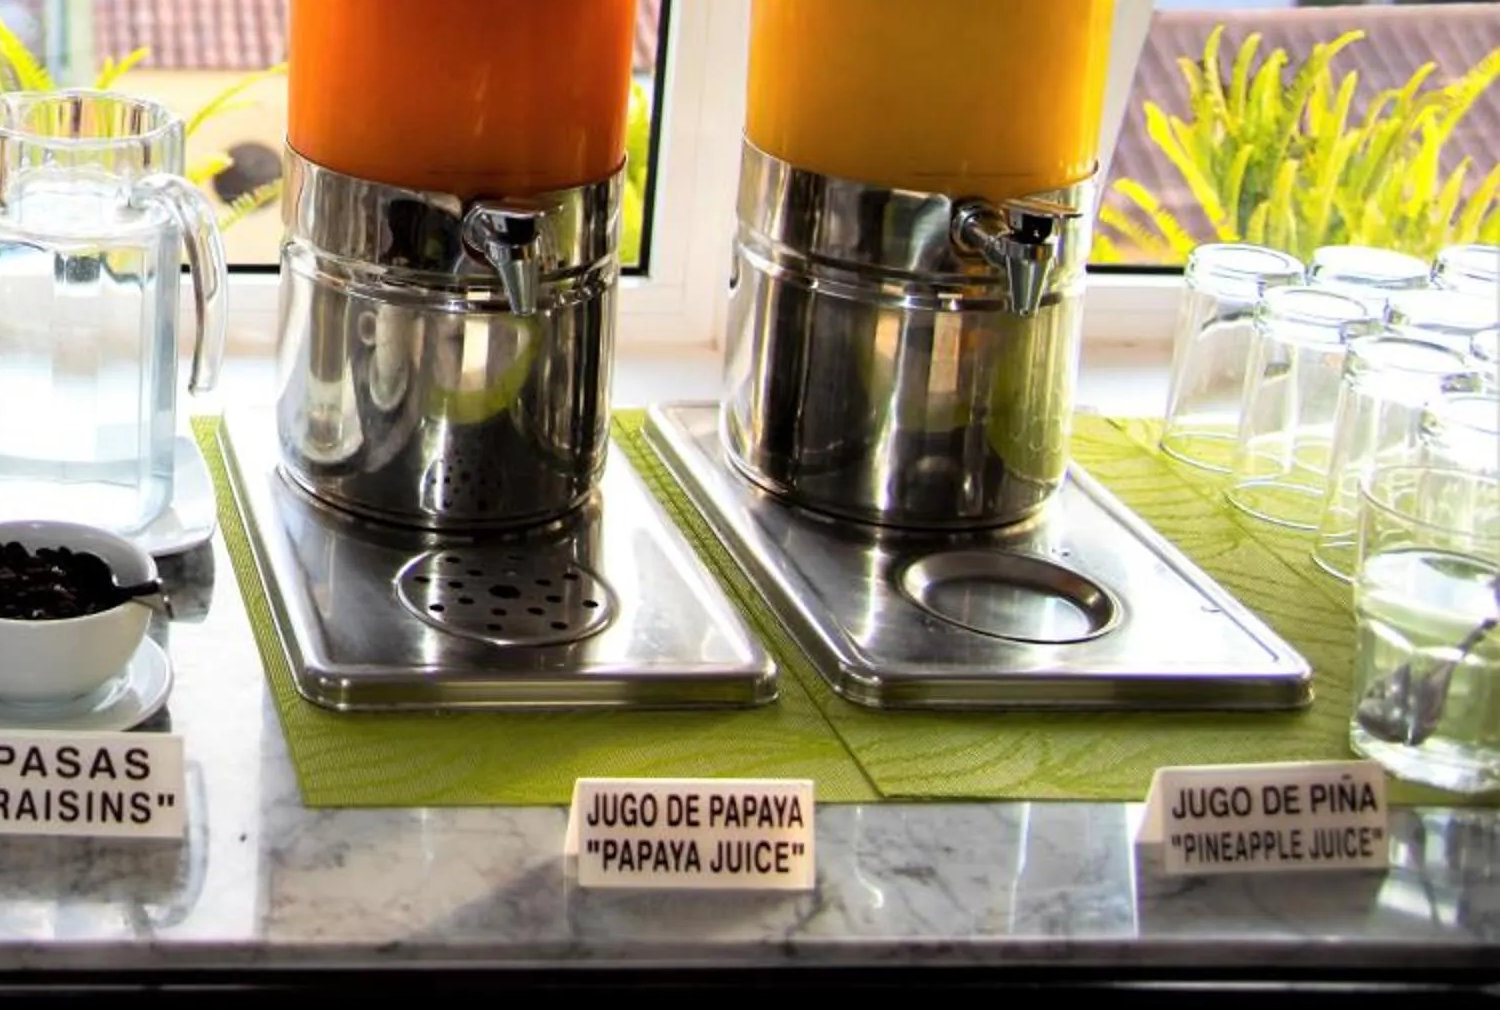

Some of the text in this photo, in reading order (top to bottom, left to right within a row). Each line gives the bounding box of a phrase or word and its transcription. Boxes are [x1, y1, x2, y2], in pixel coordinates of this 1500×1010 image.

[587, 793, 804, 828] JUGO DE PAPAYA
[1171, 774, 1378, 819] JUGO DE PIÑA
[587, 839, 805, 873] "PAPAYA JUICE"
[1171, 827, 1382, 863] "PINEAPPLE JUICE"
